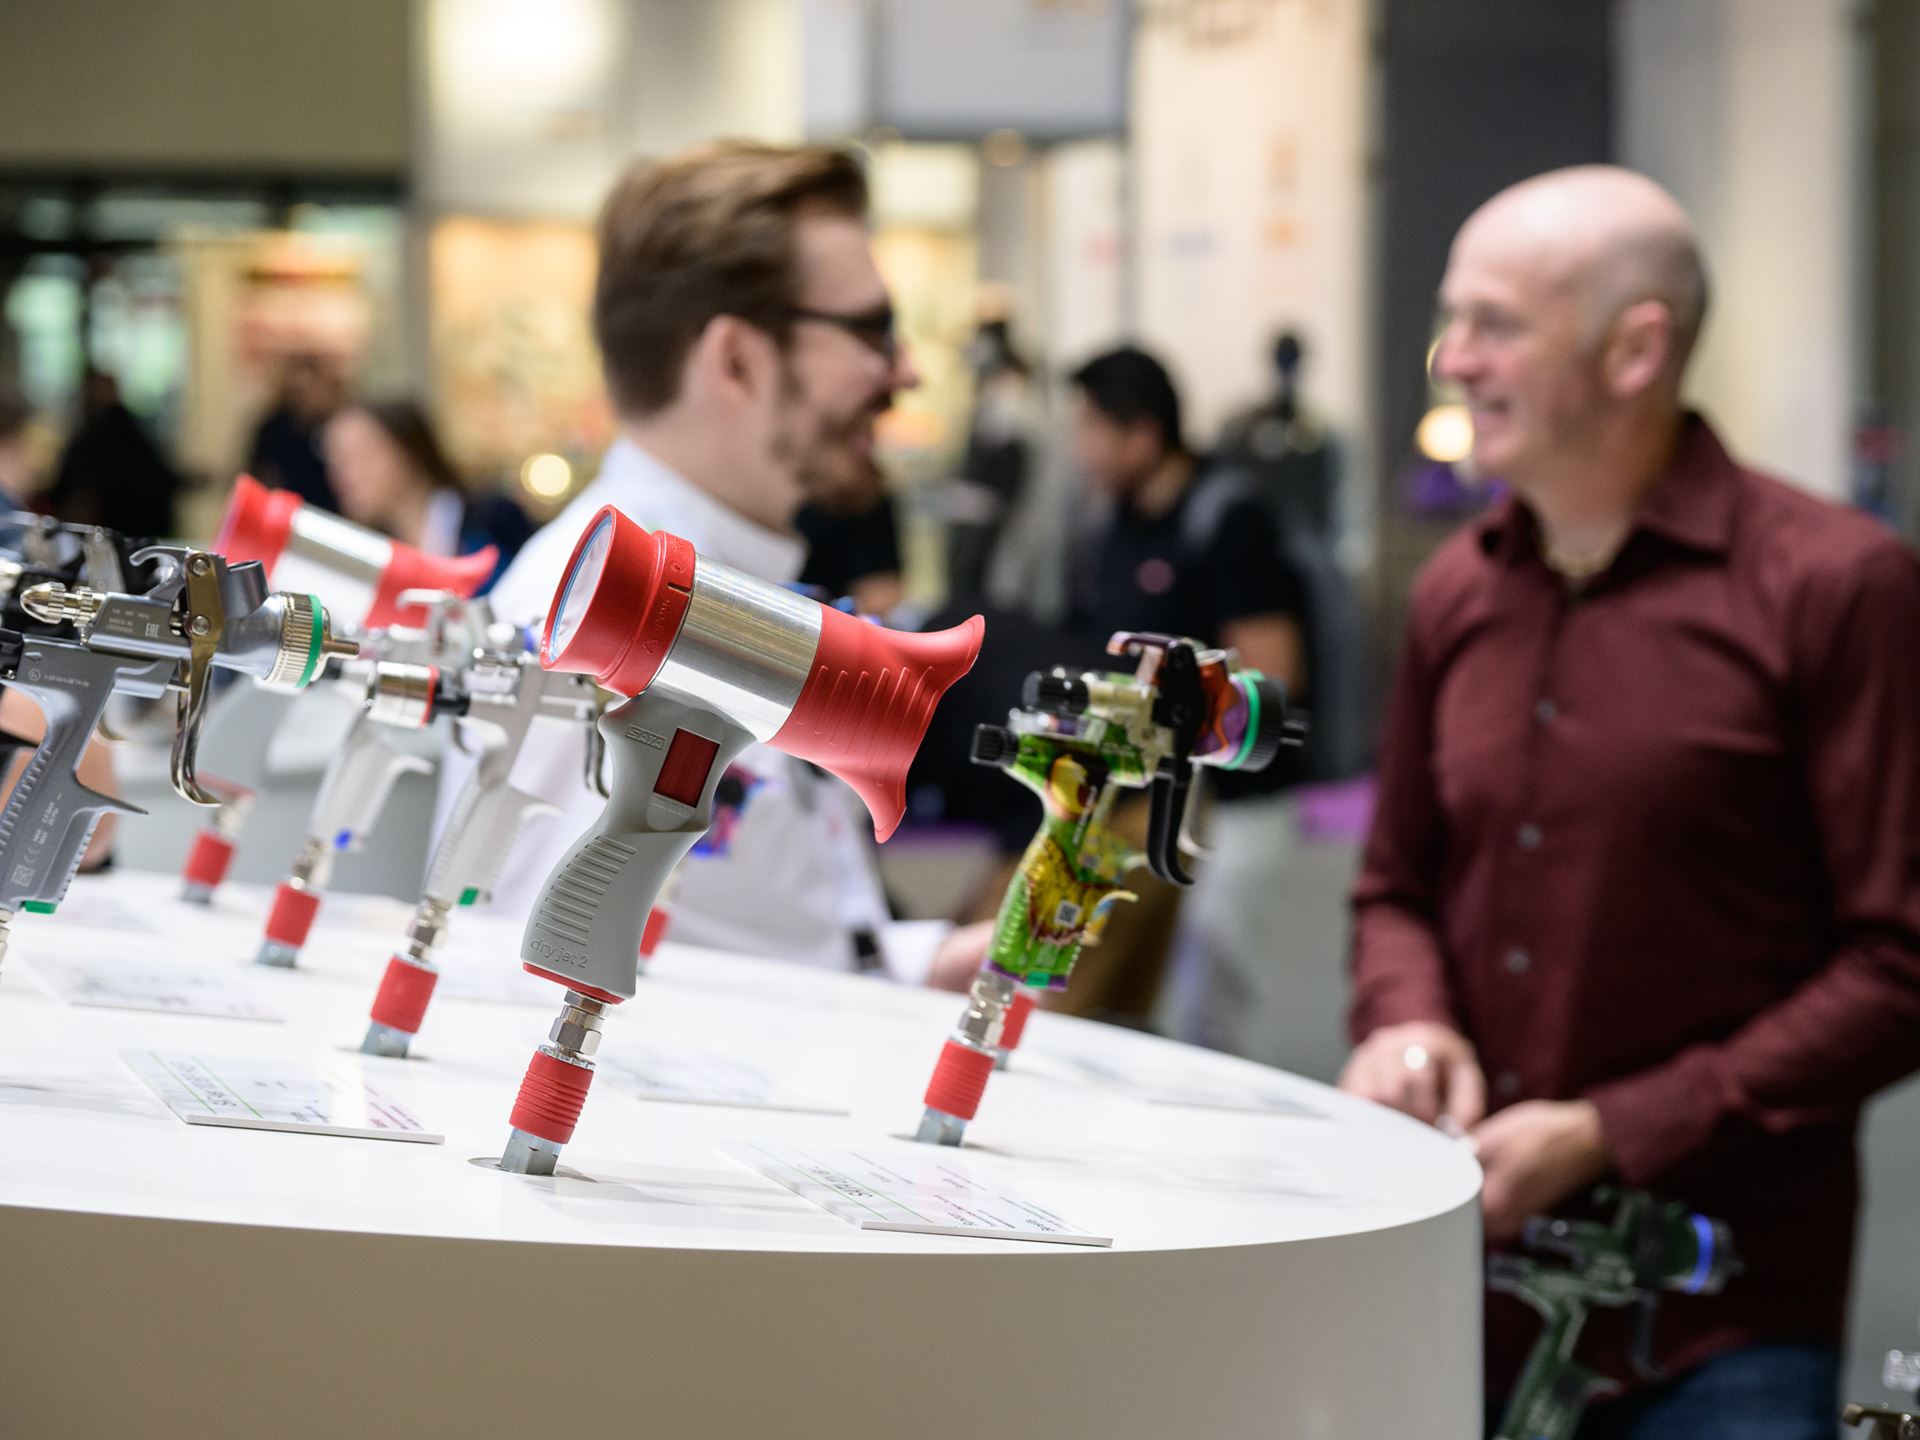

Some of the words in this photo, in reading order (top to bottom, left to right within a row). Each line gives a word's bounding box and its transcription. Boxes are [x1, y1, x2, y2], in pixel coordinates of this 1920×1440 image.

[625, 726, 664, 750] SATA
[530, 939, 556, 959] dry
[553, 946, 577, 966] jet
[577, 954, 590, 969] 2
